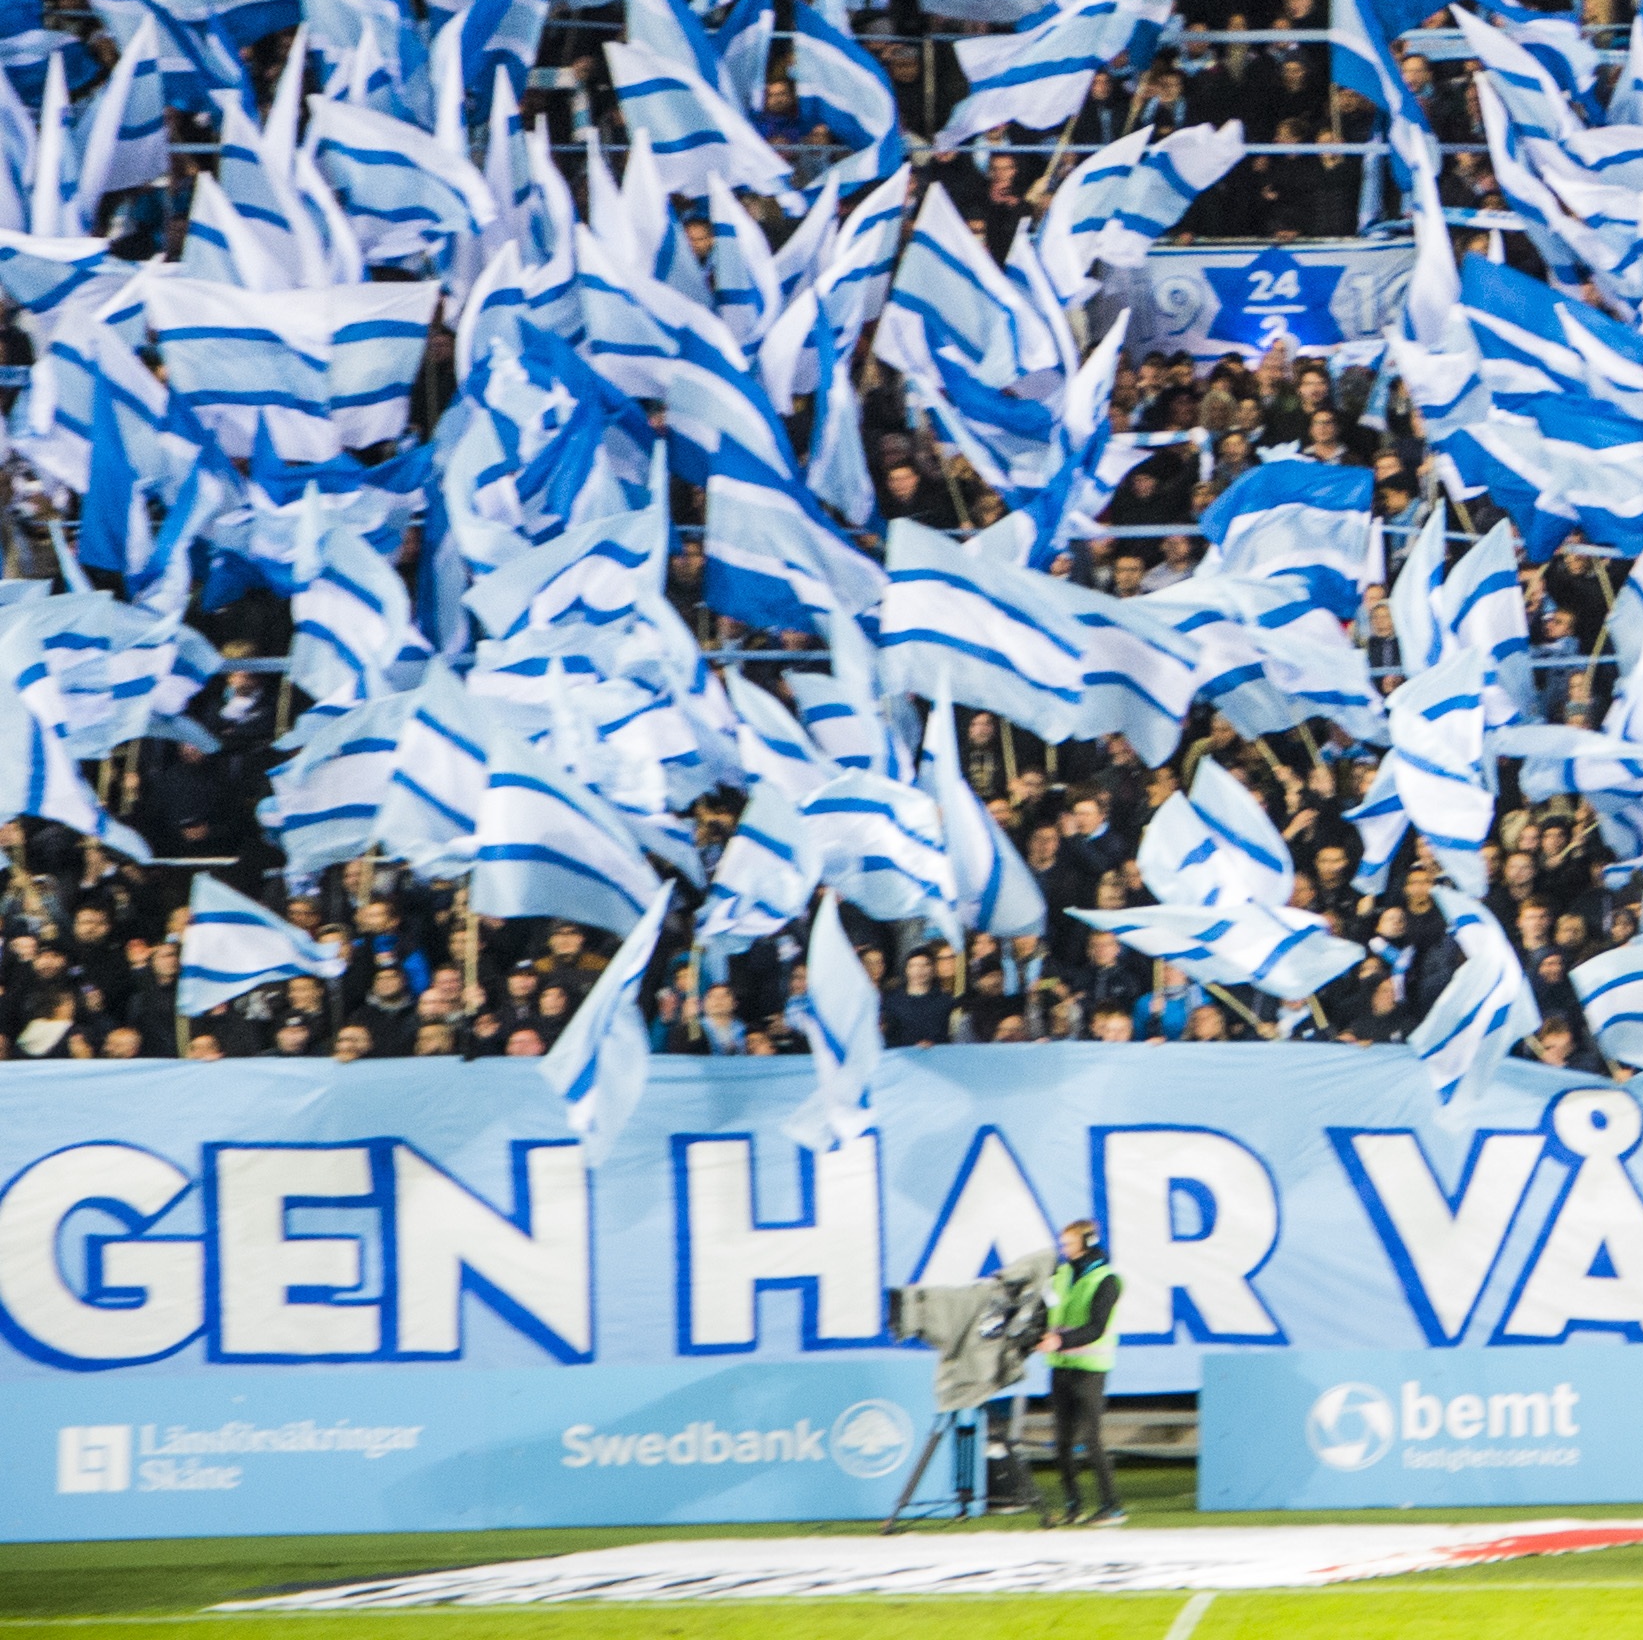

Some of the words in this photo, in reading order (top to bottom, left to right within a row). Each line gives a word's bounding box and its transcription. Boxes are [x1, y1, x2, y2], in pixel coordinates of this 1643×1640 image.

[1246, 270, 1302, 302] 24
[670, 1125, 1292, 1356] HAR
[1400, 1379, 1582, 1441] bemt
[561, 1418, 827, 1468] Swedbank
